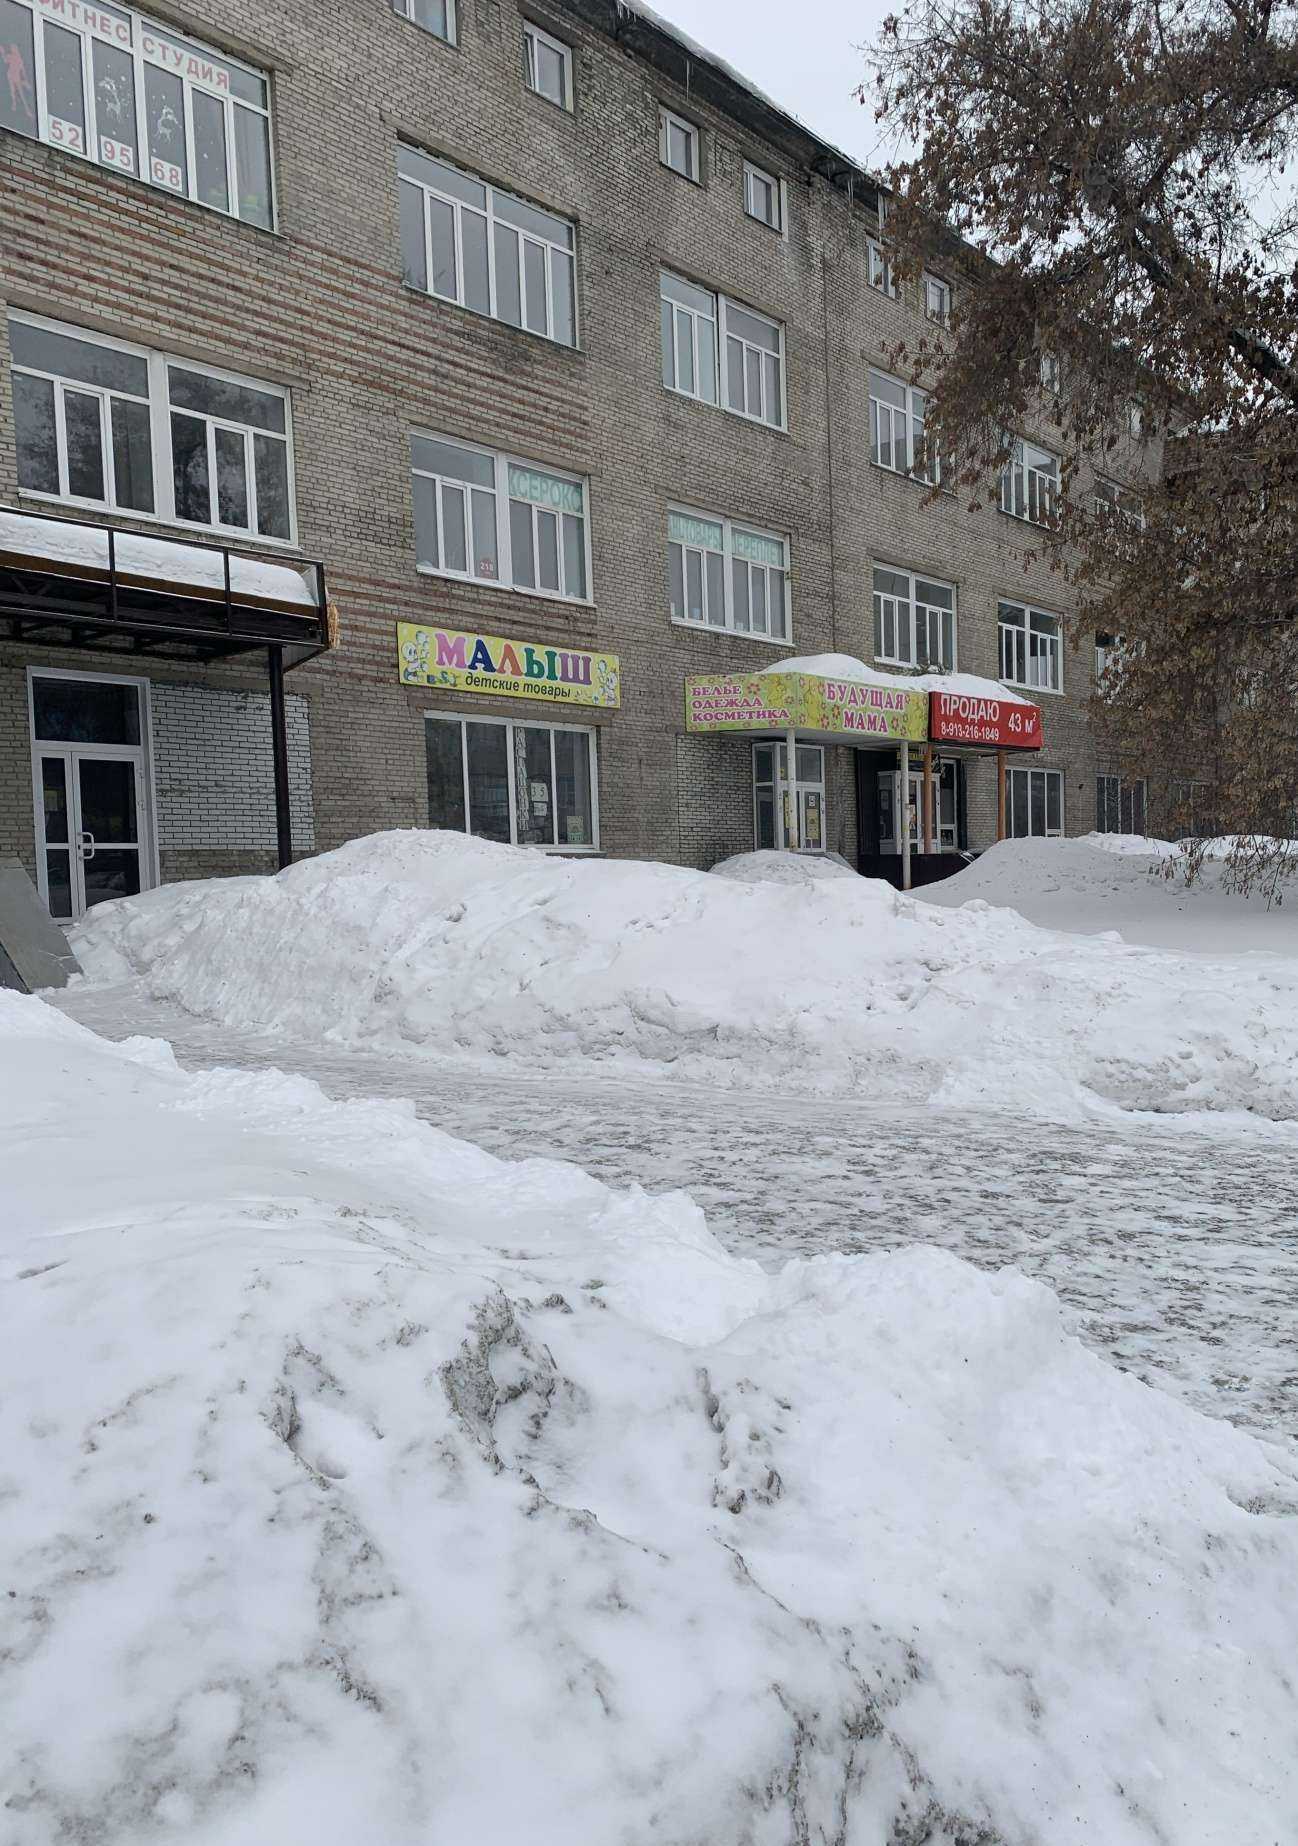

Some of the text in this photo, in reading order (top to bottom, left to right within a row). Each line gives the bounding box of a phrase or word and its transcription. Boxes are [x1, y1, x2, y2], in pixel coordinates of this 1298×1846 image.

[142, 37, 228, 90] СТУДИЯ
[51, 120, 180, 187] 52 95 68
[435, 633, 592, 685] МАЛЫШ
[465, 672, 571, 698] детские товары
[691, 685, 742, 697] БЕЛЬЕ
[826, 683, 906, 710] БУДУЩАЯ
[691, 697, 764, 709] ОДЕЖДА
[940, 694, 1000, 723] ПРОДАЮ
[691, 709, 790, 722] КОСМЕТИКА
[843, 711, 888, 732] МАМА
[1008, 713, 1022, 732] 43
[940, 721, 1000, 741] 8-913-216-1849
